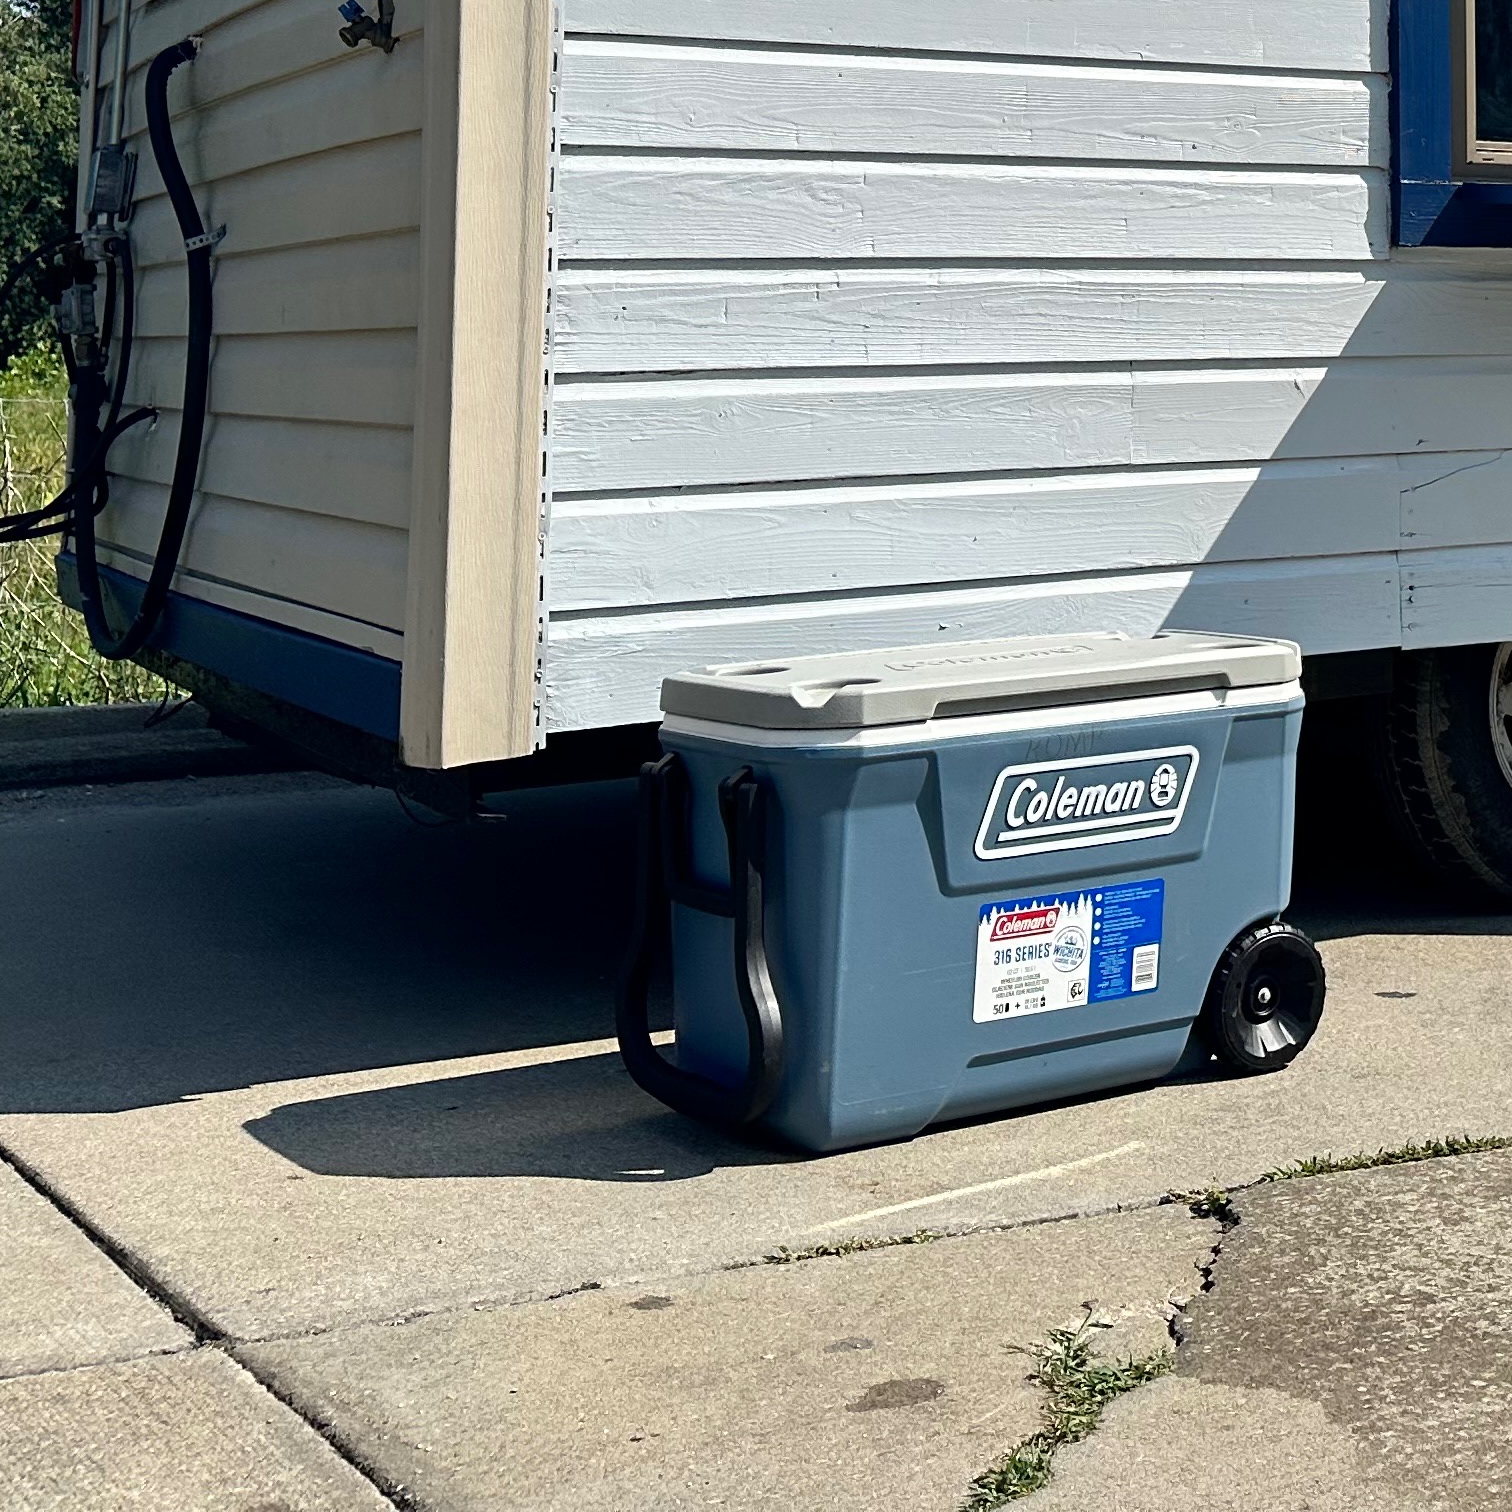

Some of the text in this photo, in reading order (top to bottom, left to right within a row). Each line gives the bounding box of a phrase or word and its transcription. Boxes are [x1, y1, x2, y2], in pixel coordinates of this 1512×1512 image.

[1005, 776, 1146, 828] Coleman
[995, 915, 1045, 936] Coleman
[993, 948, 1012, 966] 316
[1015, 942, 1050, 963] SERIES
